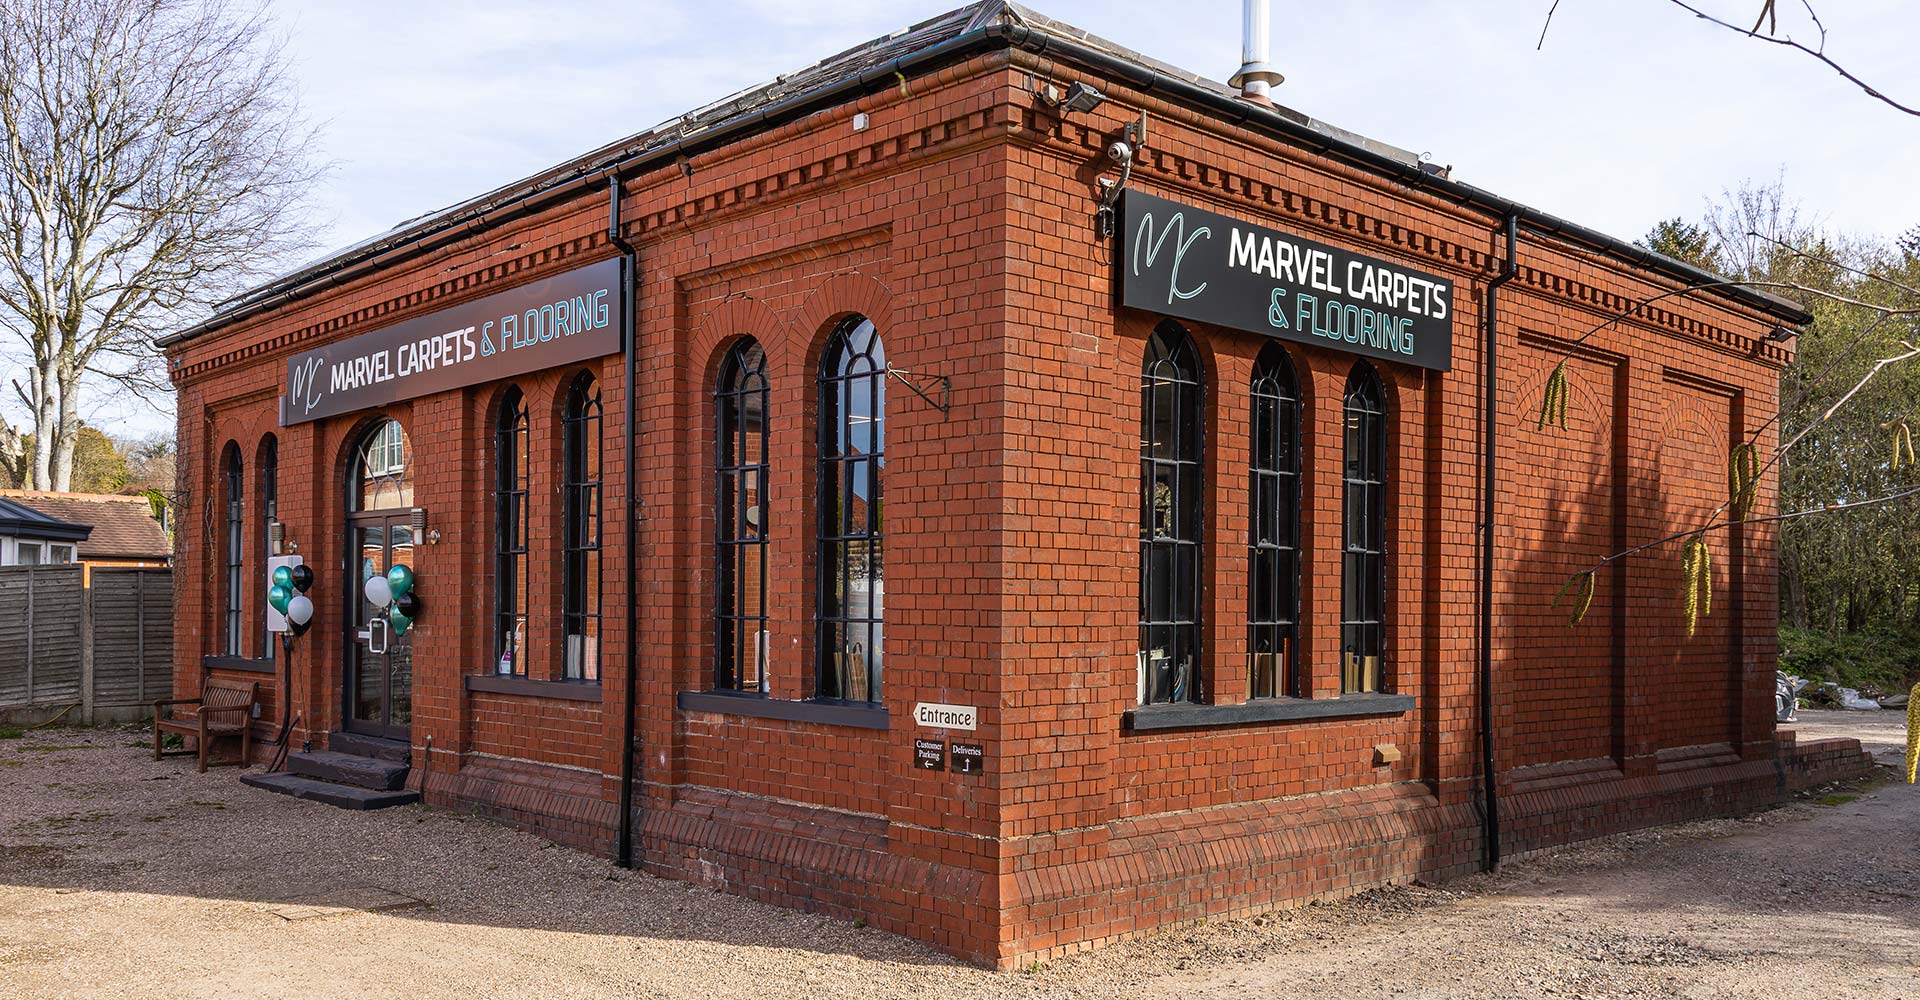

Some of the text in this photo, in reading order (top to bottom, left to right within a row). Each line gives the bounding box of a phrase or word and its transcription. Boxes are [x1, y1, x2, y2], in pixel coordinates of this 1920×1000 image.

[1133, 212, 1212, 305] MC
[1228, 227, 1448, 320] MARVEL CARPETS
[330, 288, 609, 394] MARVEL CARPETS & FLOORING
[1268, 287, 1414, 356] & FLOORING
[920, 707, 971, 726] Entrance
[916, 740, 943, 751] Customer
[918, 750, 940, 761] Parking
[952, 745, 982, 756] Deliveries
